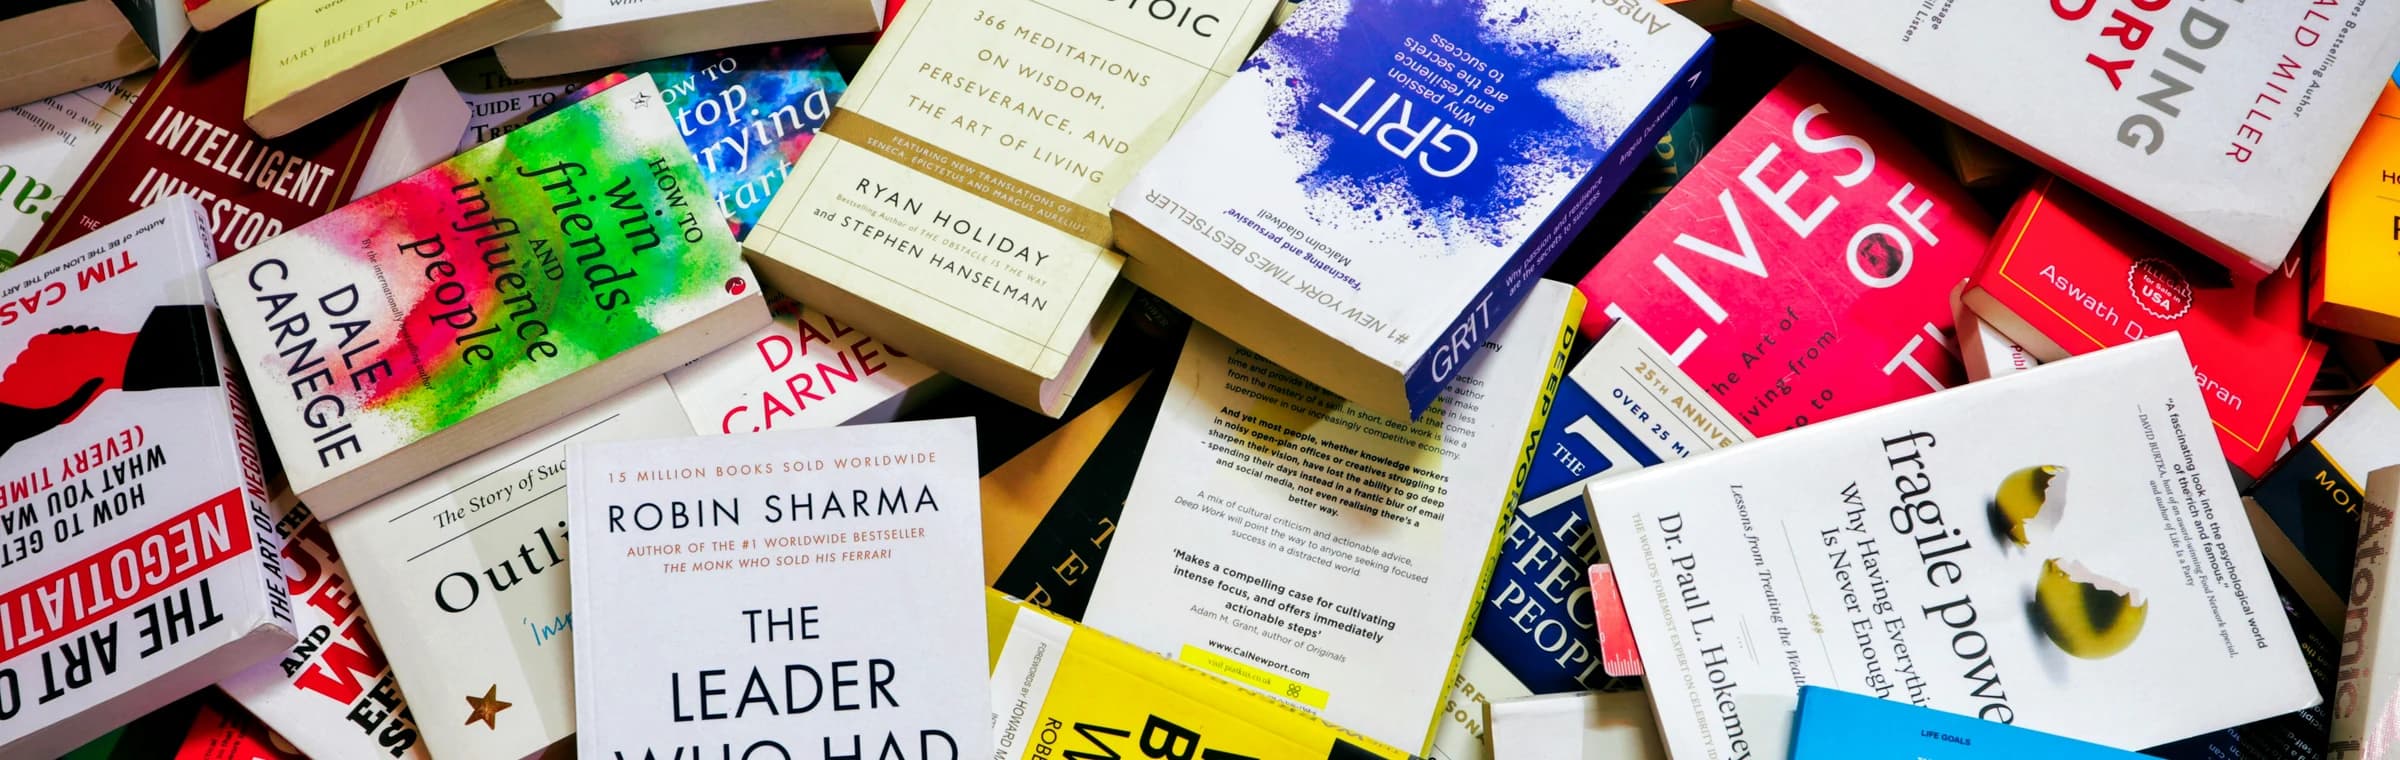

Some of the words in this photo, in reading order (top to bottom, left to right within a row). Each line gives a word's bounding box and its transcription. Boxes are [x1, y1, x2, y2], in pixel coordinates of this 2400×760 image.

[972, 8, 1007, 31] 366
[1012, 24, 1151, 87] MEDITATIONS
[1403, 36, 1456, 72] secrets
[1429, 32, 1488, 72] success
[2311, 21, 2357, 78] Bestselling
[702, 57, 736, 81] TO
[976, 47, 1009, 69] ON
[1017, 62, 1105, 110] WISDOM,
[1387, 66, 1445, 104] passion
[1393, 50, 1464, 97] resilience
[1455, 68, 1482, 89] the
[1487, 67, 1505, 83] to
[529, 92, 556, 108] TO
[917, 61, 1072, 136] PERSEVERANCE,
[1081, 128, 1130, 155] AND
[1442, 100, 1476, 127] Why
[1462, 93, 1495, 114] and
[1482, 84, 1509, 103] are
[2226, 53, 2303, 164] MILLER
[2292, 79, 2321, 118] Author
[907, 93, 947, 120] THE
[950, 114, 993, 137] ART
[998, 132, 1028, 151] OF
[1031, 145, 1105, 184] LIVING
[1318, 76, 1479, 178] GRIT
[145, 106, 334, 207] INTELLIGENT
[605, 176, 663, 257] win
[648, 157, 687, 210] HOW
[677, 217, 704, 244] TO
[854, 176, 923, 216] RYAN
[931, 209, 1049, 267] HOLIDAY
[121, 232, 133, 244] of
[134, 216, 166, 236] Author
[516, 160, 637, 313] friends
[1144, 187, 1248, 257] BESTSELLER
[1221, 207, 1284, 244] persuasive’
[1255, 207, 1305, 240] Gladwell
[1603, 103, 1876, 366] LIVES
[1846, 182, 1940, 289] OF
[61, 253, 86, 271] LION
[86, 245, 107, 260] THE
[107, 238, 121, 250] BE
[529, 237, 565, 282] AND
[812, 207, 837, 222] and
[839, 214, 924, 259] STEPHEN
[928, 252, 1048, 312] HANSELMAN
[1279, 240, 1304, 257] and
[1303, 235, 1352, 268] Malcolm
[22, 274, 42, 289] THE
[42, 265, 61, 280] and
[78, 250, 138, 291] TIM
[451, 175, 558, 363] influence
[1243, 250, 1296, 286] TIMES
[1301, 251, 1361, 292] ‘Fascinating
[0, 282, 21, 298] ART
[374, 267, 402, 323] internationally
[397, 232, 501, 366] people
[1292, 278, 1343, 313] YORK
[2040, 264, 2118, 326] Aswath
[2142, 286, 2170, 311] USA
[318, 283, 393, 392] DALE
[1339, 306, 1388, 333] NEW
[1385, 327, 1410, 345] #1
[1431, 292, 1494, 384] GRIT
[1740, 333, 1776, 369] Art
[1780, 306, 1800, 331] of
[249, 258, 362, 468] CARNEGIE
[1540, 325, 1575, 417] DEEP
[1788, 328, 1838, 376] from
[1634, 362, 1669, 396] 25TH
[1811, 388, 1834, 411] to
[1612, 388, 1648, 424] OVER
[1650, 422, 1670, 442] 25
[2164, 396, 2176, 412] “A
[61, 425, 144, 481] (EVERY
[224, 367, 266, 502] NEGOTIATION
[2168, 412, 2196, 472] fascinating
[101, 444, 167, 493] WHAT
[608, 470, 627, 483] 15
[635, 466, 706, 482] MILLION
[714, 462, 773, 478] BOOKS
[782, 458, 824, 473] SOLD
[832, 450, 936, 470] WORLDWIDE
[1552, 442, 1586, 477] THE
[2172, 462, 2186, 475] of
[48, 479, 94, 517] YOU
[432, 506, 466, 529] The
[468, 483, 513, 513] Story
[517, 468, 534, 492] of
[1499, 429, 1540, 537] WORK
[2177, 475, 2191, 495] the
[2189, 472, 2207, 498] look
[93, 483, 145, 527] HOW
[251, 501, 272, 533] OF
[607, 496, 739, 533] ROBIN
[764, 484, 939, 524] SHARMA
[1882, 430, 1971, 587] fragile
[2184, 495, 2200, 518] rich
[2199, 497, 2214, 521] into
[1, 529, 43, 568] GET
[54, 513, 85, 543] TO
[625, 542, 682, 558] AUTHOR
[686, 541, 705, 554] OF
[710, 539, 735, 552] THE
[740, 538, 756, 550] #1
[763, 531, 847, 549] WORLDWIDE
[852, 526, 925, 543] BESTSELLER
[1841, 481, 1867, 533] Why
[1858, 538, 1893, 616] Having
[2192, 519, 2210, 541] and
[2208, 521, 2222, 540] the
[259, 535, 285, 580] ART
[662, 561, 687, 574] THE
[691, 558, 733, 572] MONK
[737, 556, 771, 568] WHO
[774, 553, 810, 567] SOLD
[814, 551, 836, 564] HIS
[841, 547, 892, 562] FERRARI
[1658, 511, 1682, 550] Dr.
[1671, 553, 1709, 611] Paul
[1690, 613, 1713, 642] L.
[2201, 541, 2230, 588] famous.”
[2214, 541, 2255, 616] psychological
[270, 582, 292, 624] THE
[1172, 547, 1211, 569] ‘Makes
[1211, 562, 1220, 572] a
[1221, 566, 1286, 596] compelling
[1287, 588, 1314, 604] case
[1315, 595, 1334, 609] for
[1334, 603, 1396, 631] cultivating
[1172, 563, 1215, 587] intense
[1216, 578, 1250, 601] focus,
[1252, 593, 1277, 608] and
[1276, 601, 1311, 619] offers
[1312, 611, 1384, 644] immediately
[134, 577, 224, 658] THE
[742, 606, 820, 643] THE
[1223, 600, 1285, 628] actionable
[1286, 621, 1322, 639] steps’
[1820, 527, 1834, 547] Is
[1830, 552, 1862, 612] Never
[1854, 618, 1894, 698] Enough
[2335, 502, 2394, 720] Atomic
[280, 624, 330, 678] AND
[2246, 616, 2269, 649] world
[38, 620, 118, 705] ART
[1207, 638, 1310, 680] www.CalNewport.com
[672, 658, 900, 722] LEADER
[1921, 729, 1938, 741] LIFE
[1941, 732, 1971, 746] GOALS
